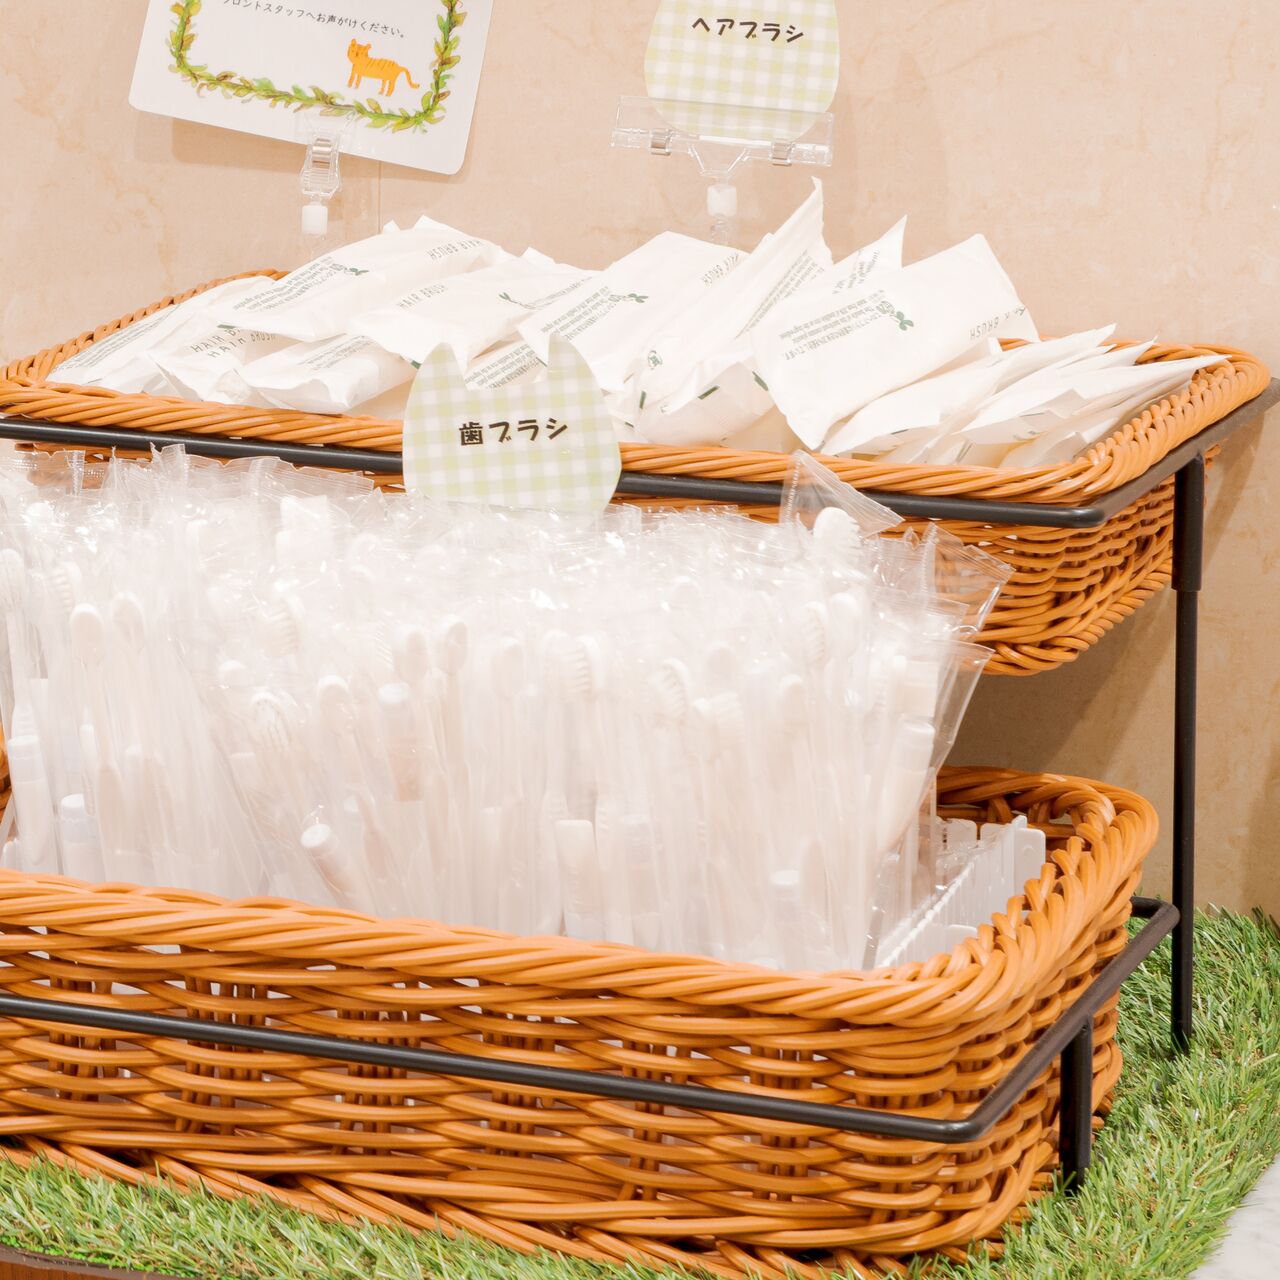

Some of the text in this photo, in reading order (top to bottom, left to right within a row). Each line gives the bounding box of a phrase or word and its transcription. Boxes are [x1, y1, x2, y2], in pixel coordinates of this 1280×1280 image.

[691, 17, 805, 44] ヘアブラシ
[458, 417, 569, 446] 歯ブラシ
